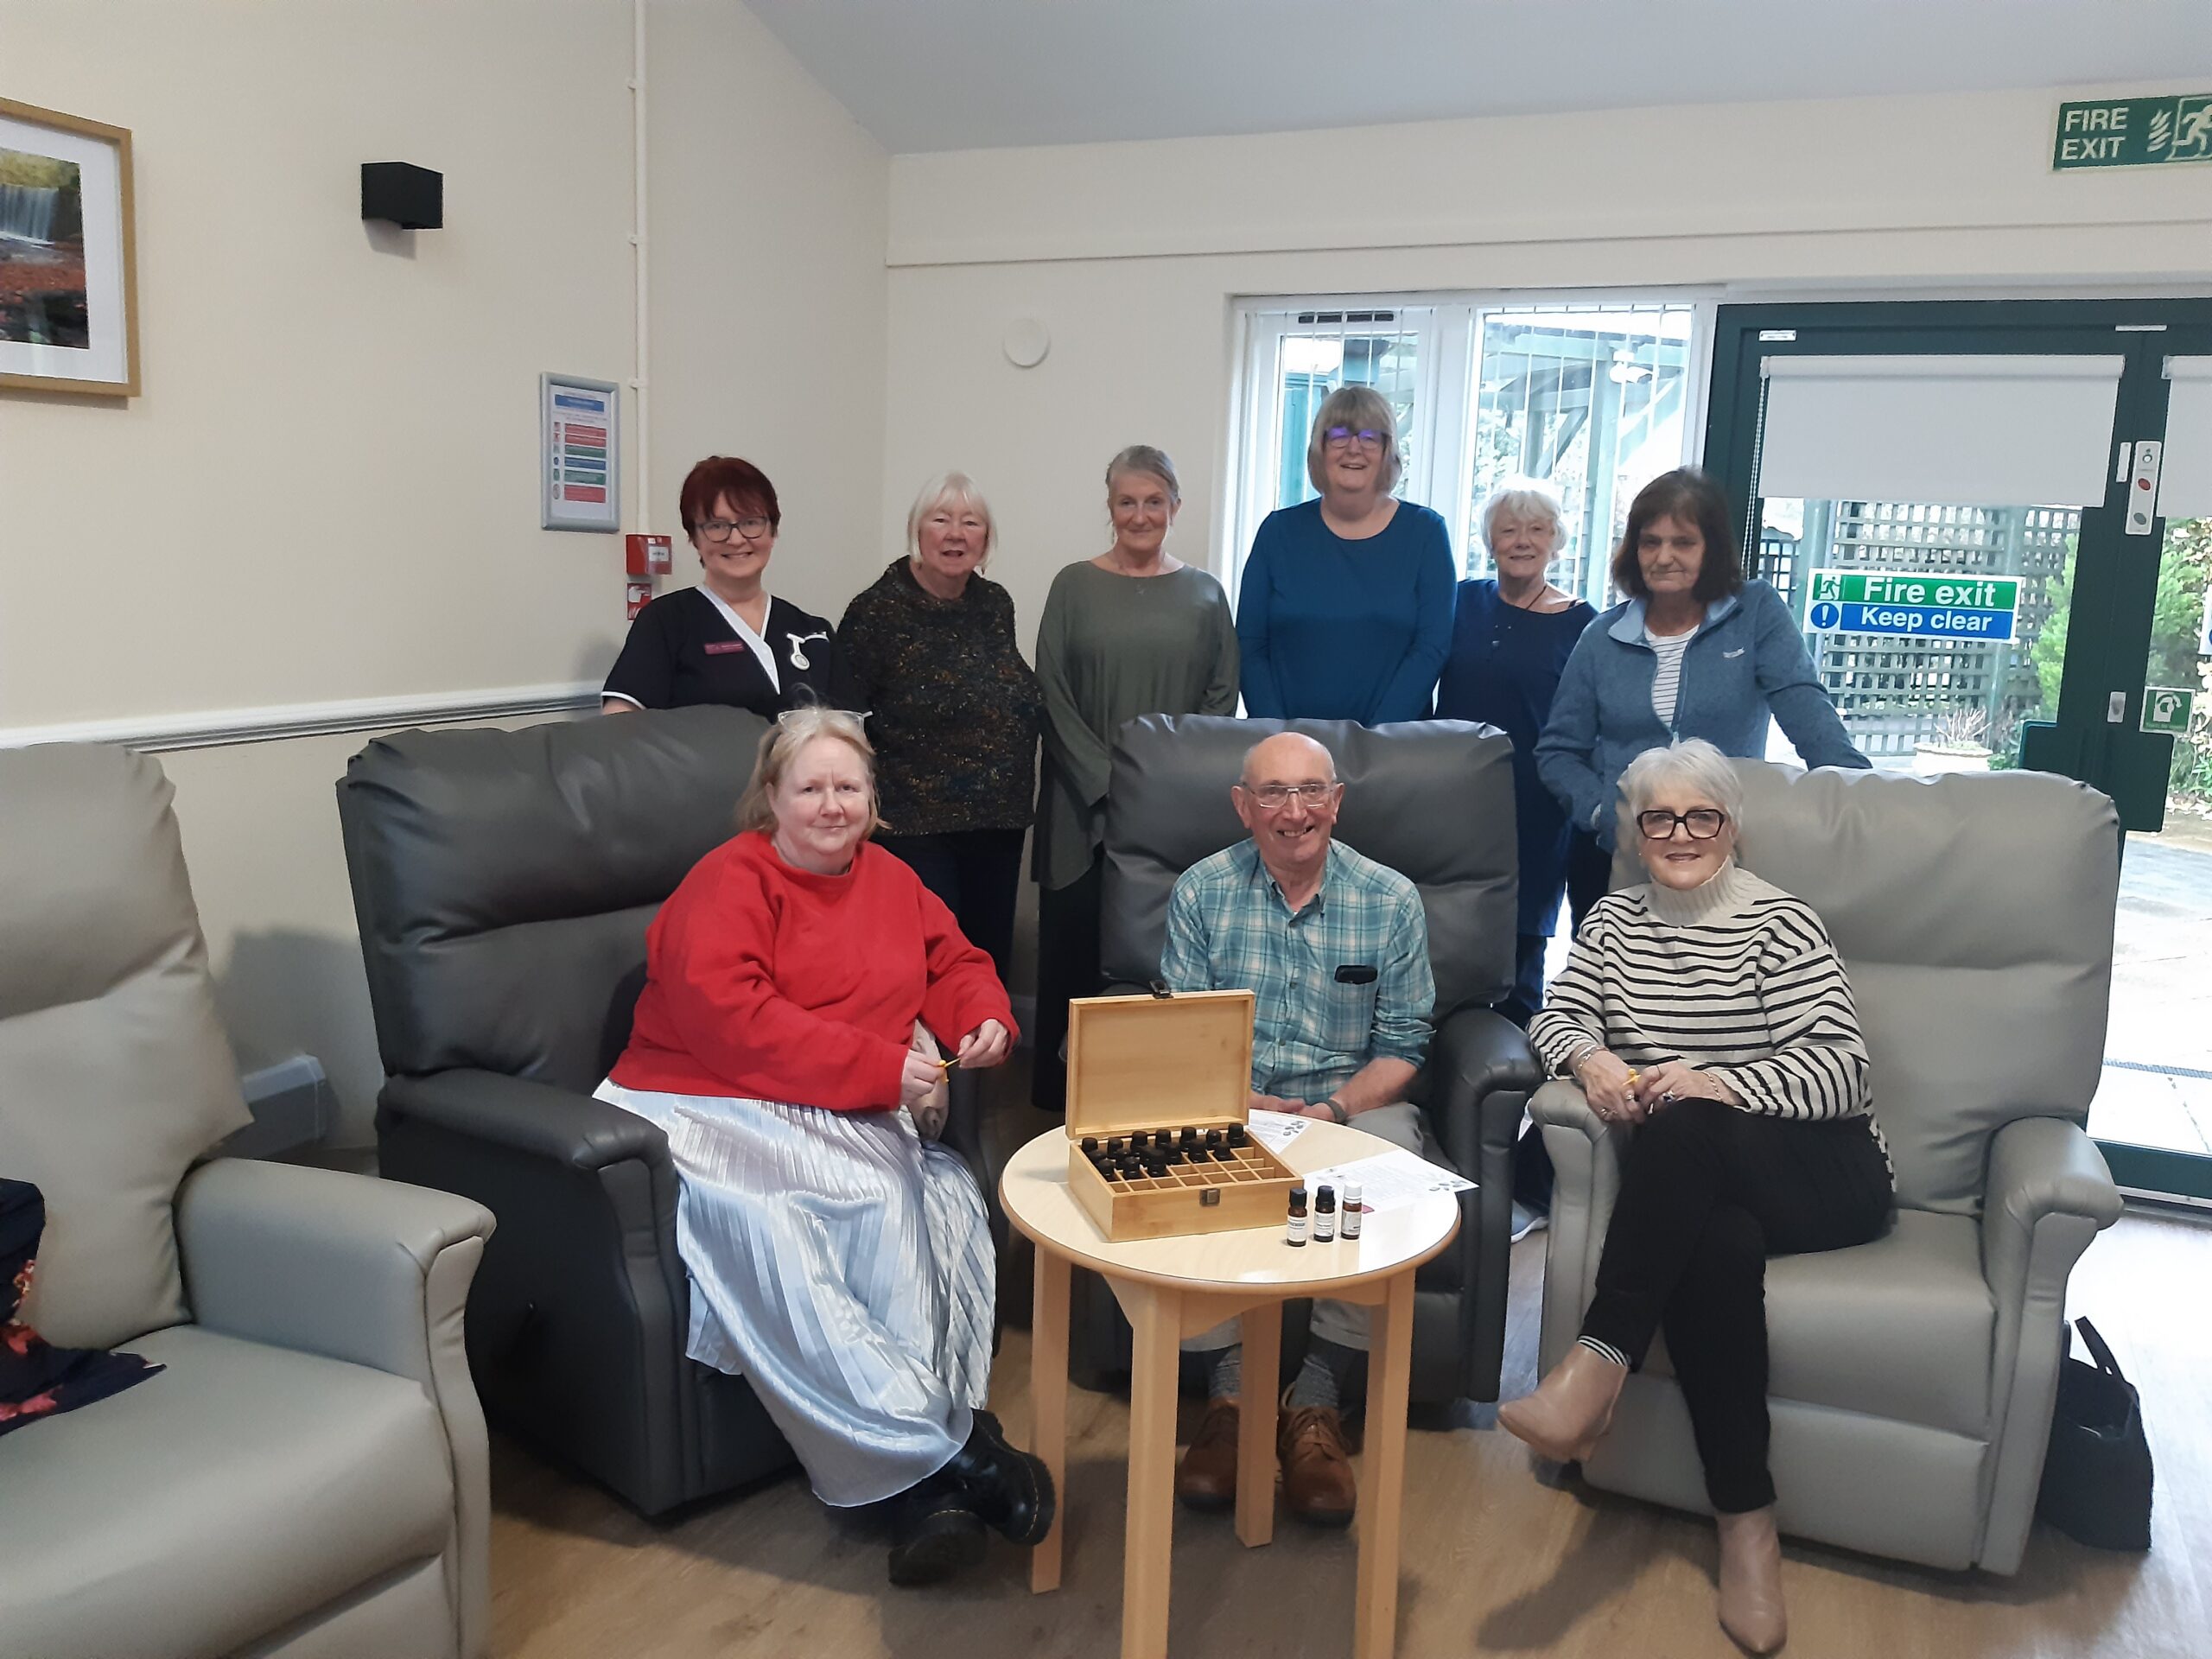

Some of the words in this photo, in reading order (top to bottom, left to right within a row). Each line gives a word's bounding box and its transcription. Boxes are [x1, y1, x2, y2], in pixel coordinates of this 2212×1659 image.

[2065, 107, 2129, 131] FIRE
[2062, 137, 2126, 160] EXIT
[1863, 576, 1926, 603] Fire
[1935, 581, 1996, 607] exit
[1860, 606, 1923, 632] Keep
[1930, 609, 1993, 632] clear
